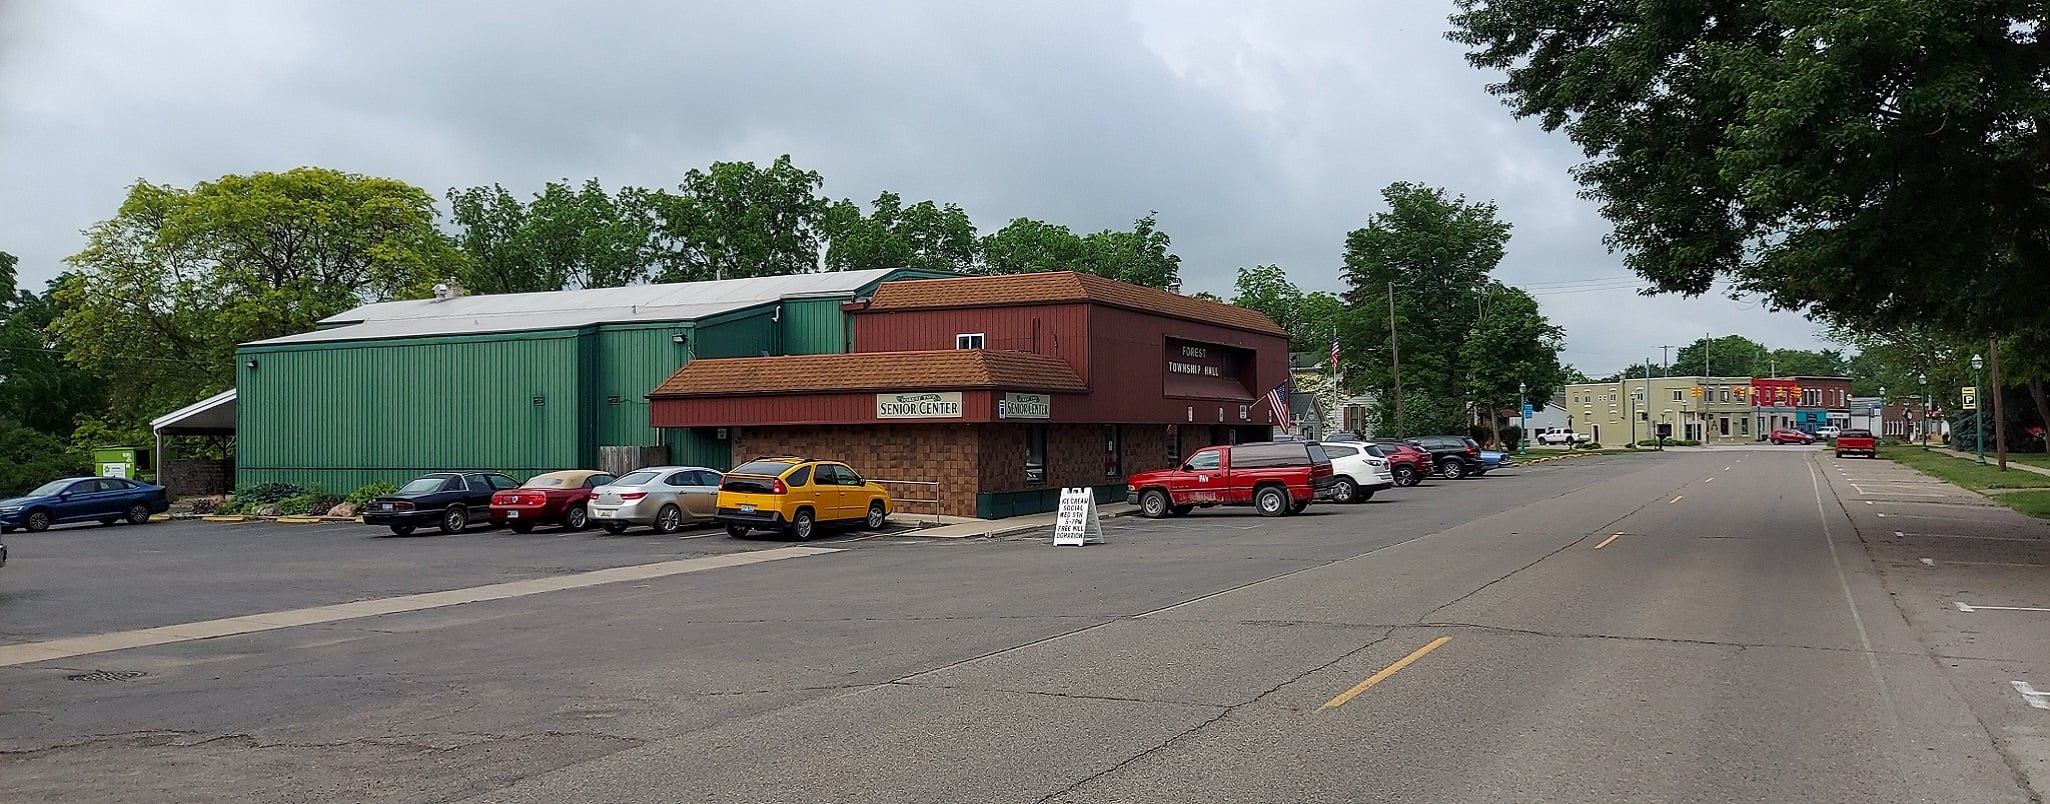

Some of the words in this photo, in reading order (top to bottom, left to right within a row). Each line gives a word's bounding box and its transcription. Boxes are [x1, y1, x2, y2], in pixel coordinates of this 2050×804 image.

[1182, 346, 1206, 358] FOREST
[1168, 361, 1201, 375] TOWNSHIP
[1204, 366, 1219, 376] HALL
[880, 402, 917, 415] SENIOR
[919, 401, 958, 415] CENTER
[1007, 401, 1028, 415] SENIOR
[1028, 402, 1048, 415] CENTER
